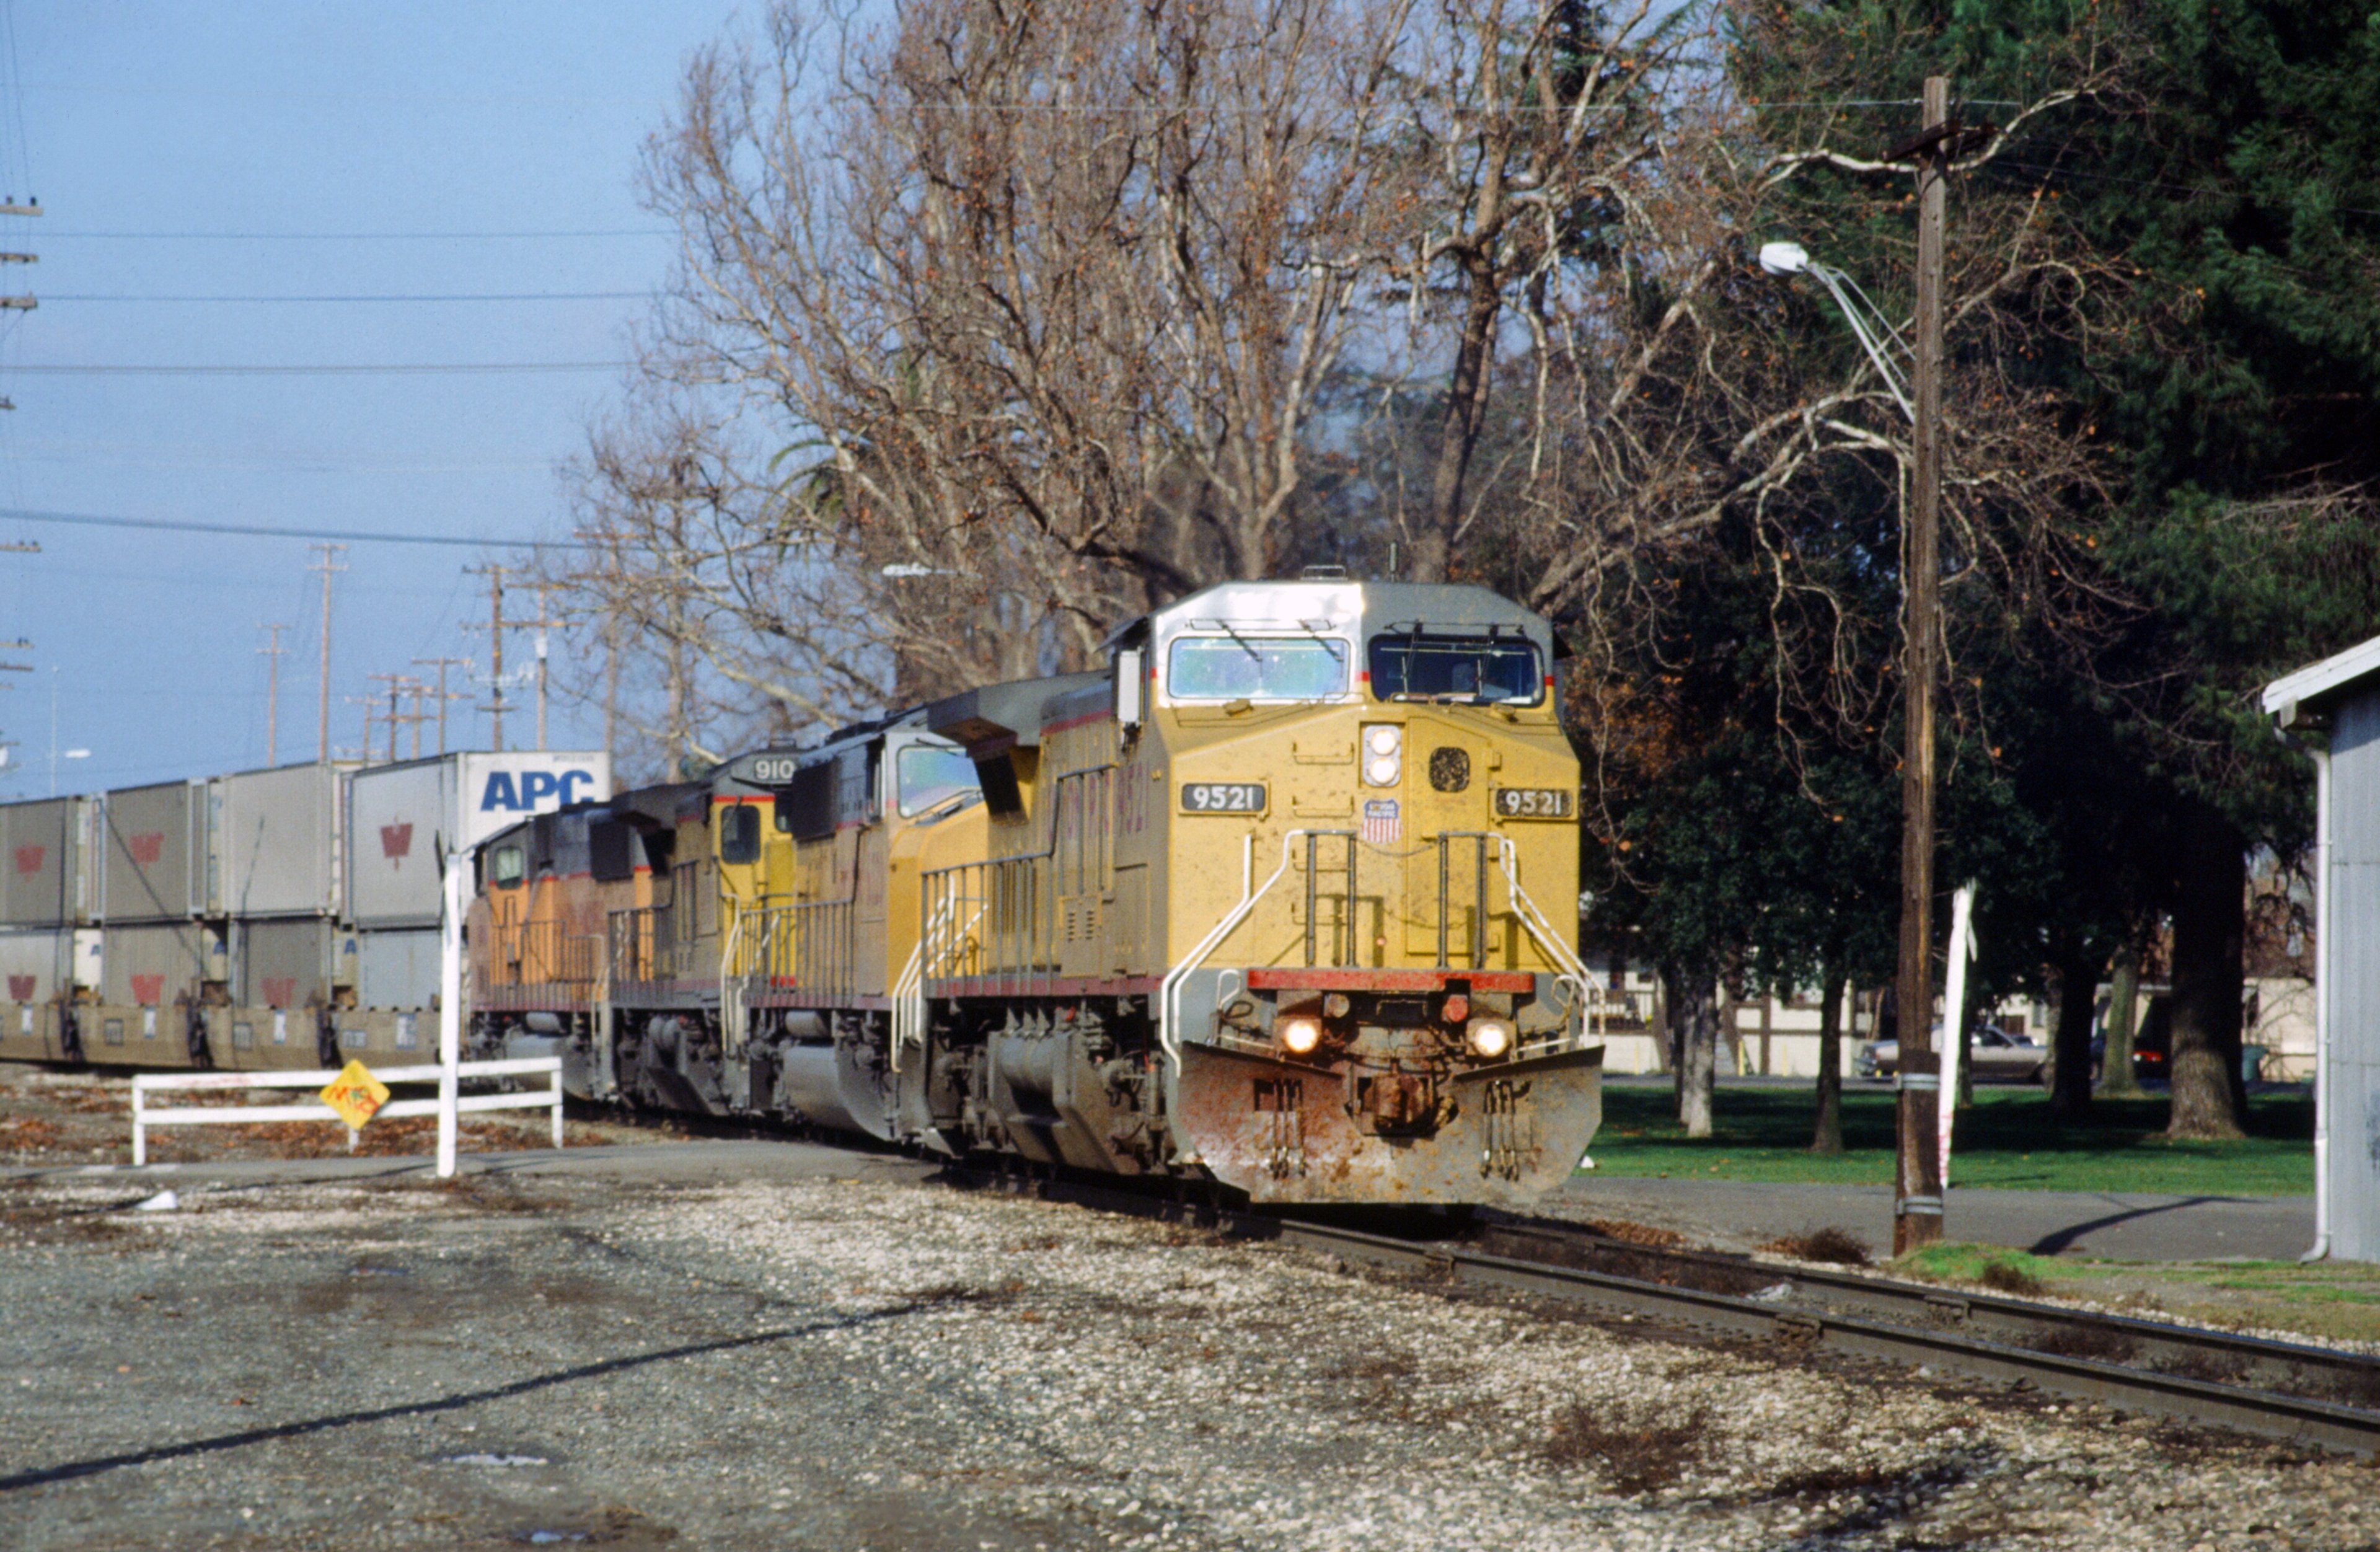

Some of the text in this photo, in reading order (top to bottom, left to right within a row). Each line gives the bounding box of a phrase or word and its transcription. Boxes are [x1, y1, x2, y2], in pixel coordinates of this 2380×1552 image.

[756, 760, 797, 779] 910
[480, 770, 594, 811] APC
[1193, 786, 1253, 809] 9521
[1505, 790, 1561, 814] 9521
